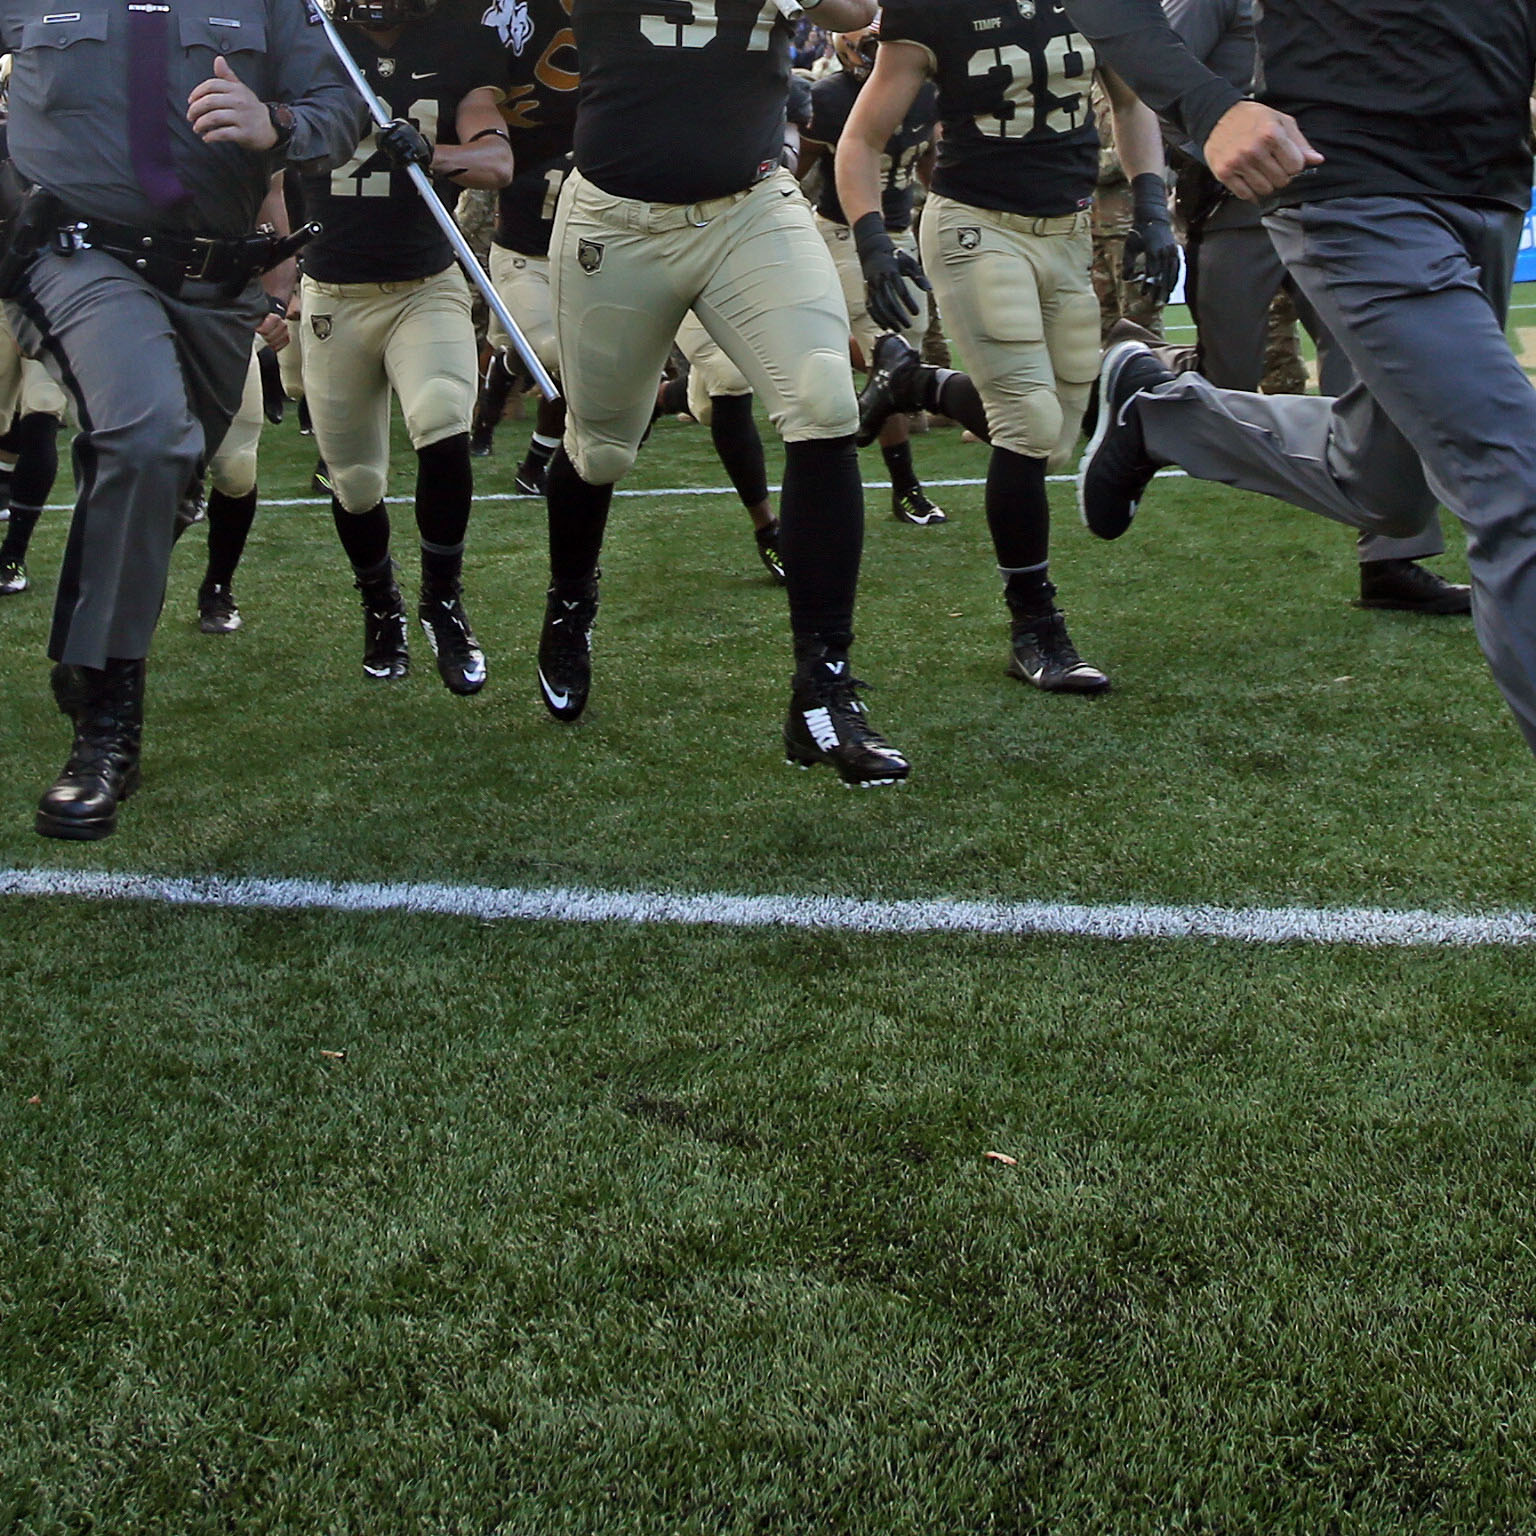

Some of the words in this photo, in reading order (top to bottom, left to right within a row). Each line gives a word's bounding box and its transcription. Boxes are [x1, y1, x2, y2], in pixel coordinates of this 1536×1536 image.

[972, 16, 1002, 31] TIMPF
[967, 32, 1096, 138] 39
[802, 706, 840, 753] NIKE
